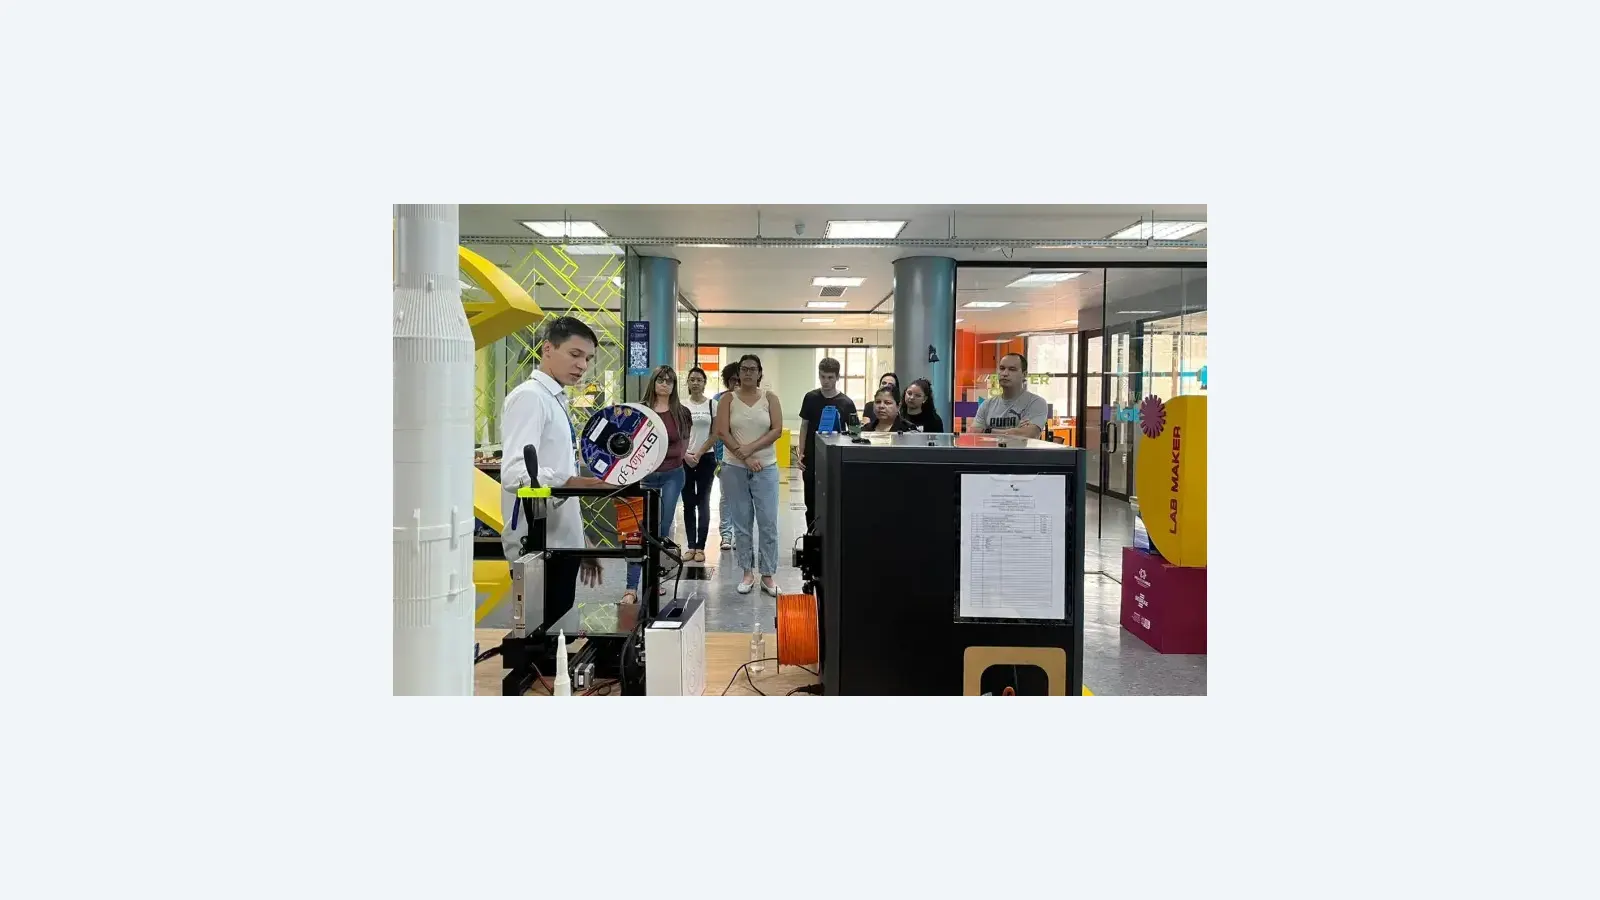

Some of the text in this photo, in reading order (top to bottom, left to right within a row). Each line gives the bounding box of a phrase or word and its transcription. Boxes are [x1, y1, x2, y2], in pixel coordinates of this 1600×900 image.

[990, 417, 1017, 428] PUMA
[1169, 425, 1182, 535] LAB MAKER
